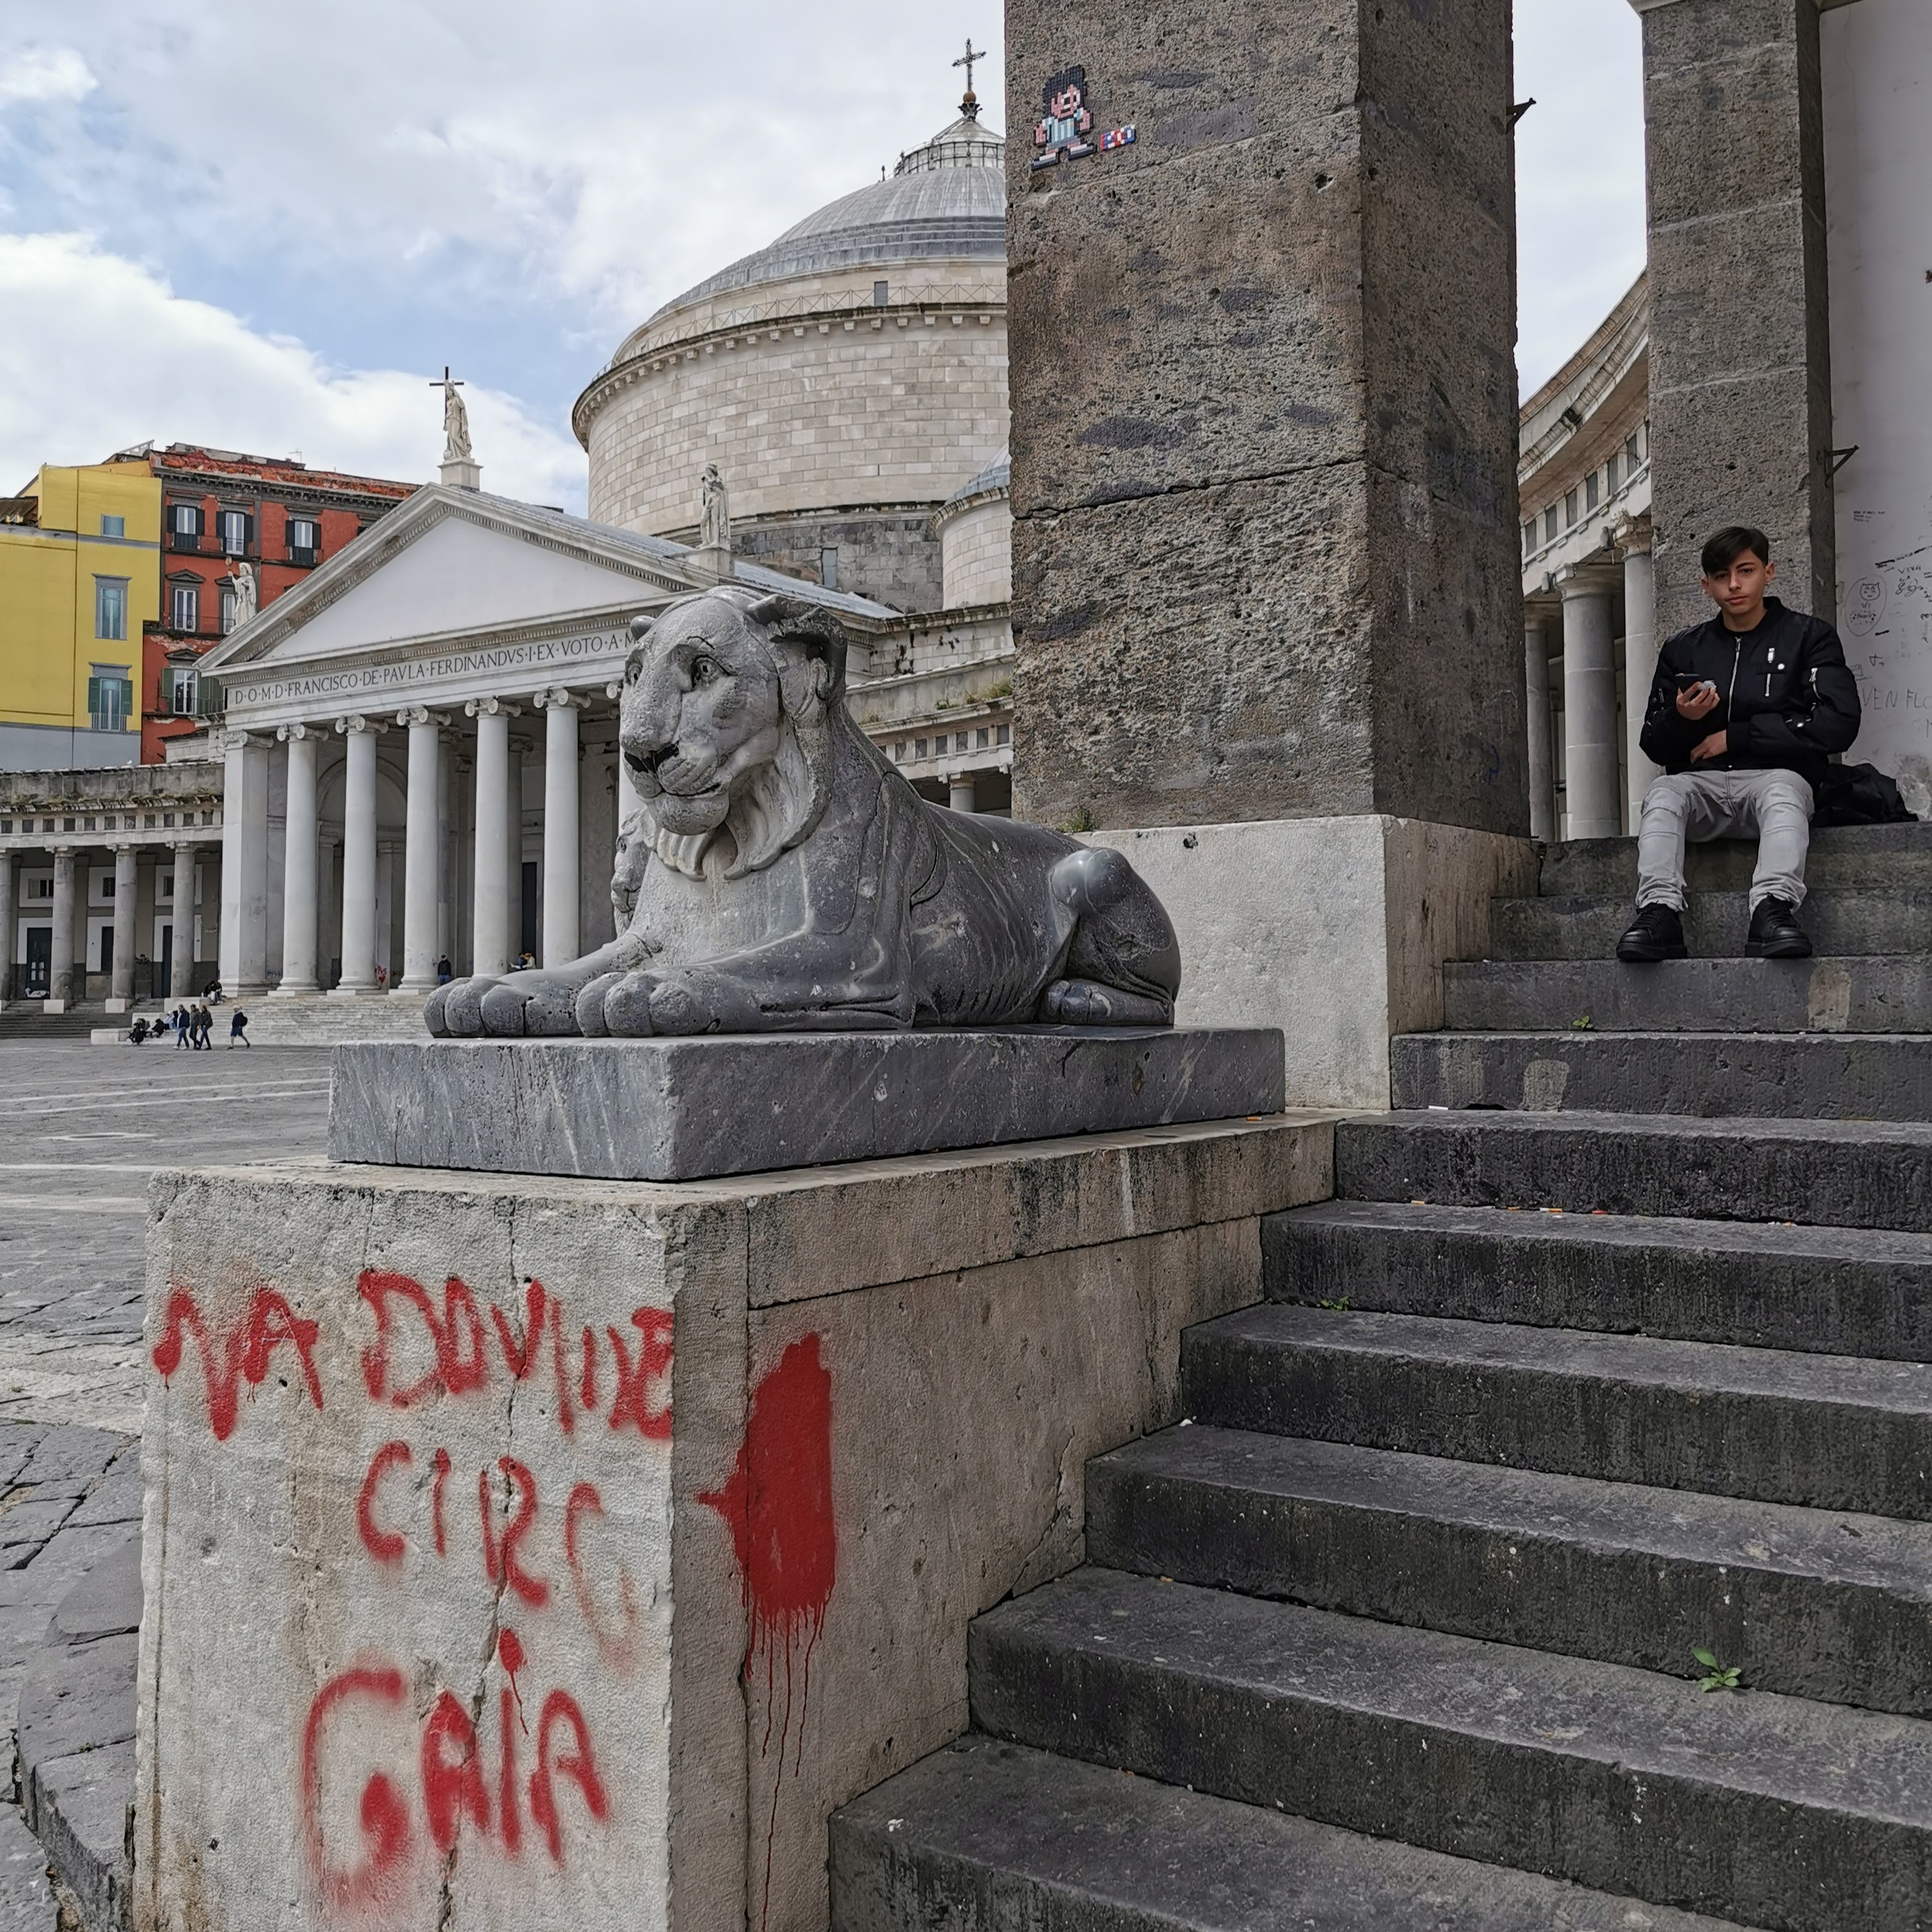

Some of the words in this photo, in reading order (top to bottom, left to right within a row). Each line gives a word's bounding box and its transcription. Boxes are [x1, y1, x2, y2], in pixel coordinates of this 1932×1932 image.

[287, 673, 358, 697] FRANCISCO
[362, 670, 378, 686] DE
[383, 663, 425, 683] PAVLA
[430, 648, 524, 676] FERDINANDVS
[537, 643, 555, 661] EX
[561, 636, 603, 657] VOTO
